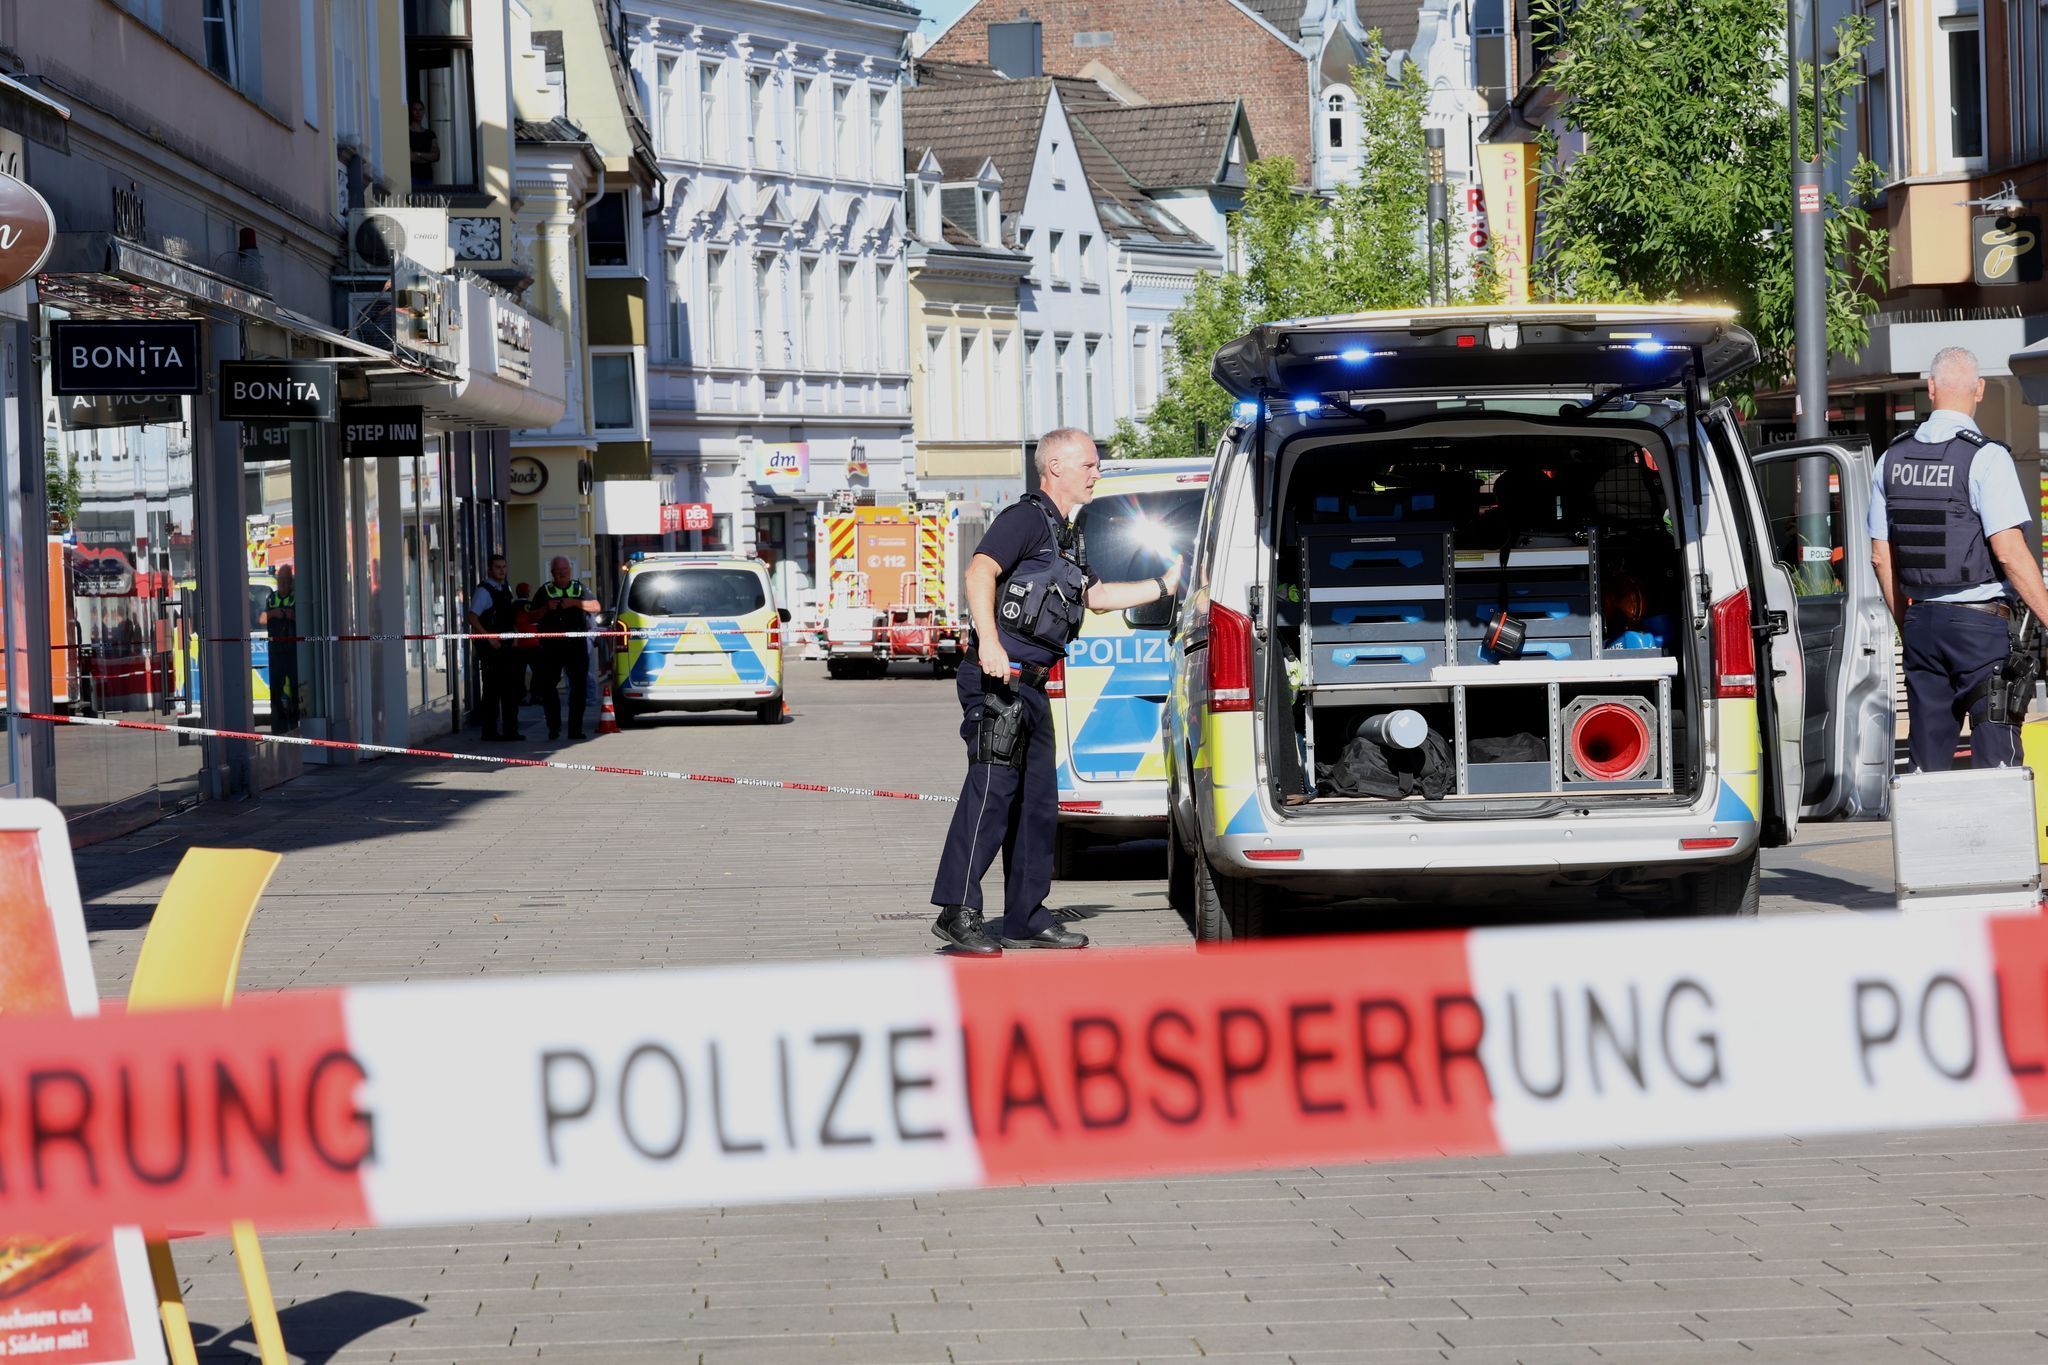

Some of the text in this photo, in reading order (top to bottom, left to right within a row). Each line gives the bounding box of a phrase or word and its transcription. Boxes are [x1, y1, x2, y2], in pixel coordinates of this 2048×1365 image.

[1503, 151, 1521, 304] SPIELHALL
[346, 423, 417, 441] STEP INN
[770, 451, 796, 468] dm
[851, 439, 866, 462] dm
[1891, 463, 1955, 487] POLIZEI
[686, 508, 708, 519] DER
[687, 518, 708, 529] TOUR
[883, 555, 906, 568] 112
[0, 1050, 379, 1192] RUNG
[541, 977, 1724, 1166] POLIZEIABSPERRUNG
